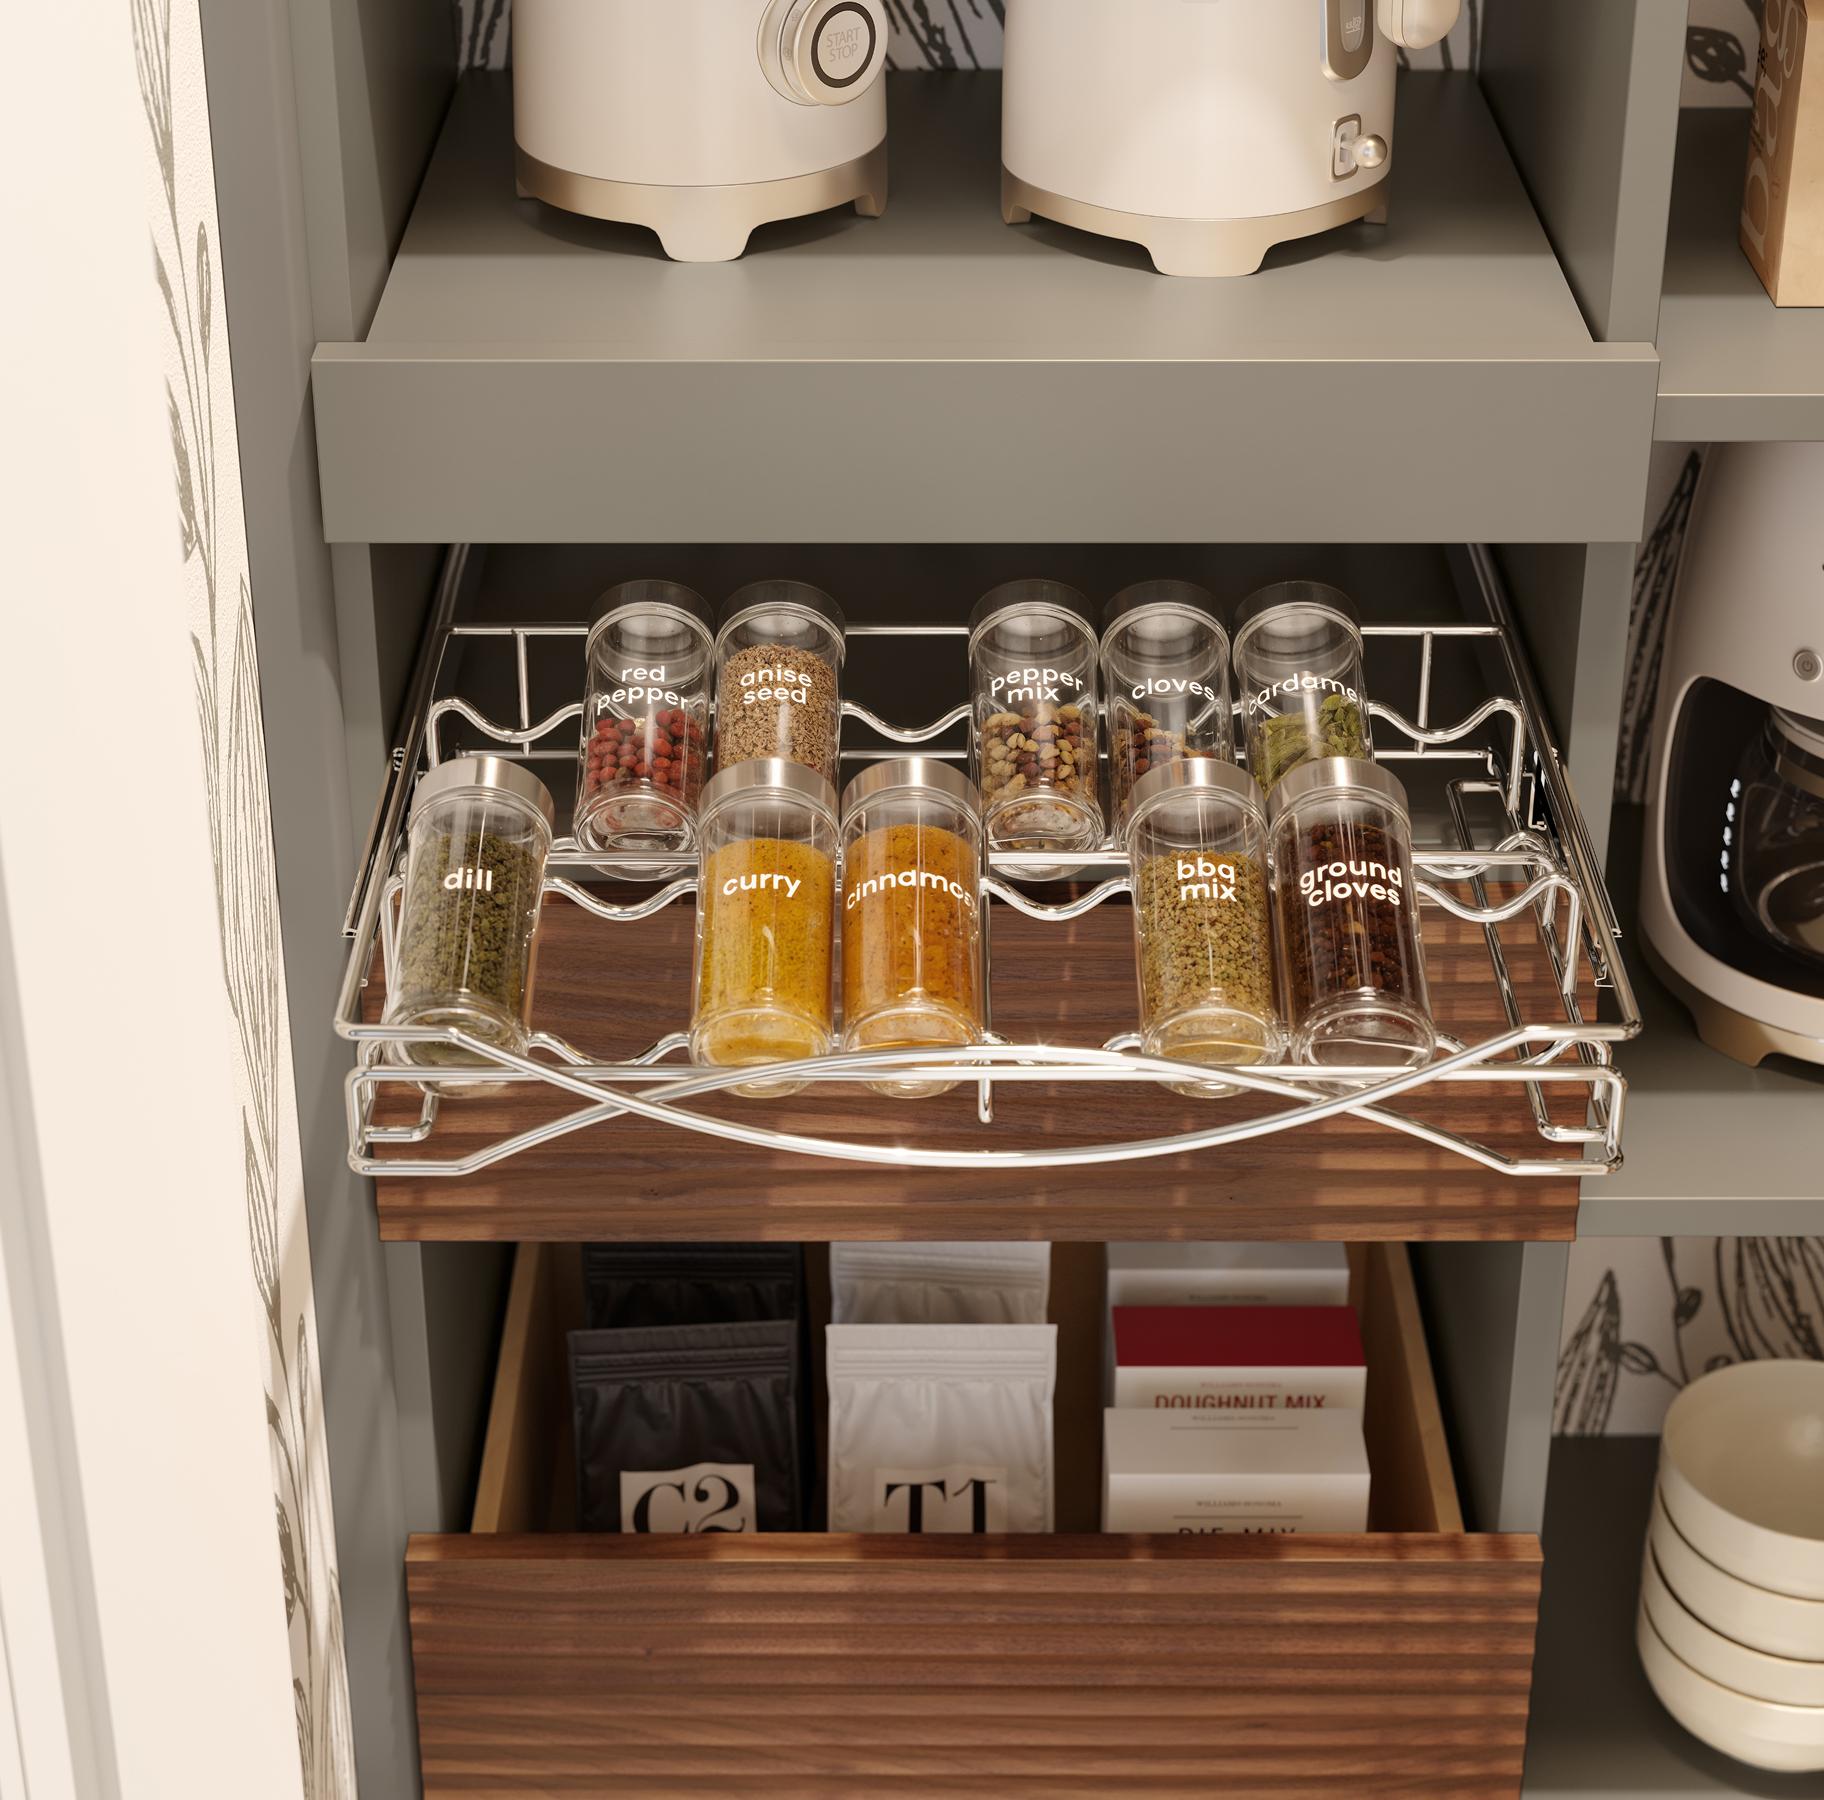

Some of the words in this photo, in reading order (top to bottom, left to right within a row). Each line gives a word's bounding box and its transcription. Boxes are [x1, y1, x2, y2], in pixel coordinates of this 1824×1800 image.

[826, 27, 862, 48] START
[829, 43, 859, 62] STOP
[621, 665, 665, 682] red
[740, 664, 812, 687] anise
[991, 668, 1084, 696] pepper
[597, 686, 689, 715] pepper
[743, 687, 807, 704] seed
[1007, 682, 1060, 703] mix
[1131, 677, 1215, 701] cloves
[443, 867, 493, 892] dill
[1176, 857, 1236, 884] bbq
[1299, 860, 1403, 895] ground
[723, 873, 802, 898] curry
[1181, 878, 1238, 902] mix
[1308, 880, 1401, 907] cloves
[632, 1474, 746, 1533] C2
[883, 1478, 997, 1533] T1
